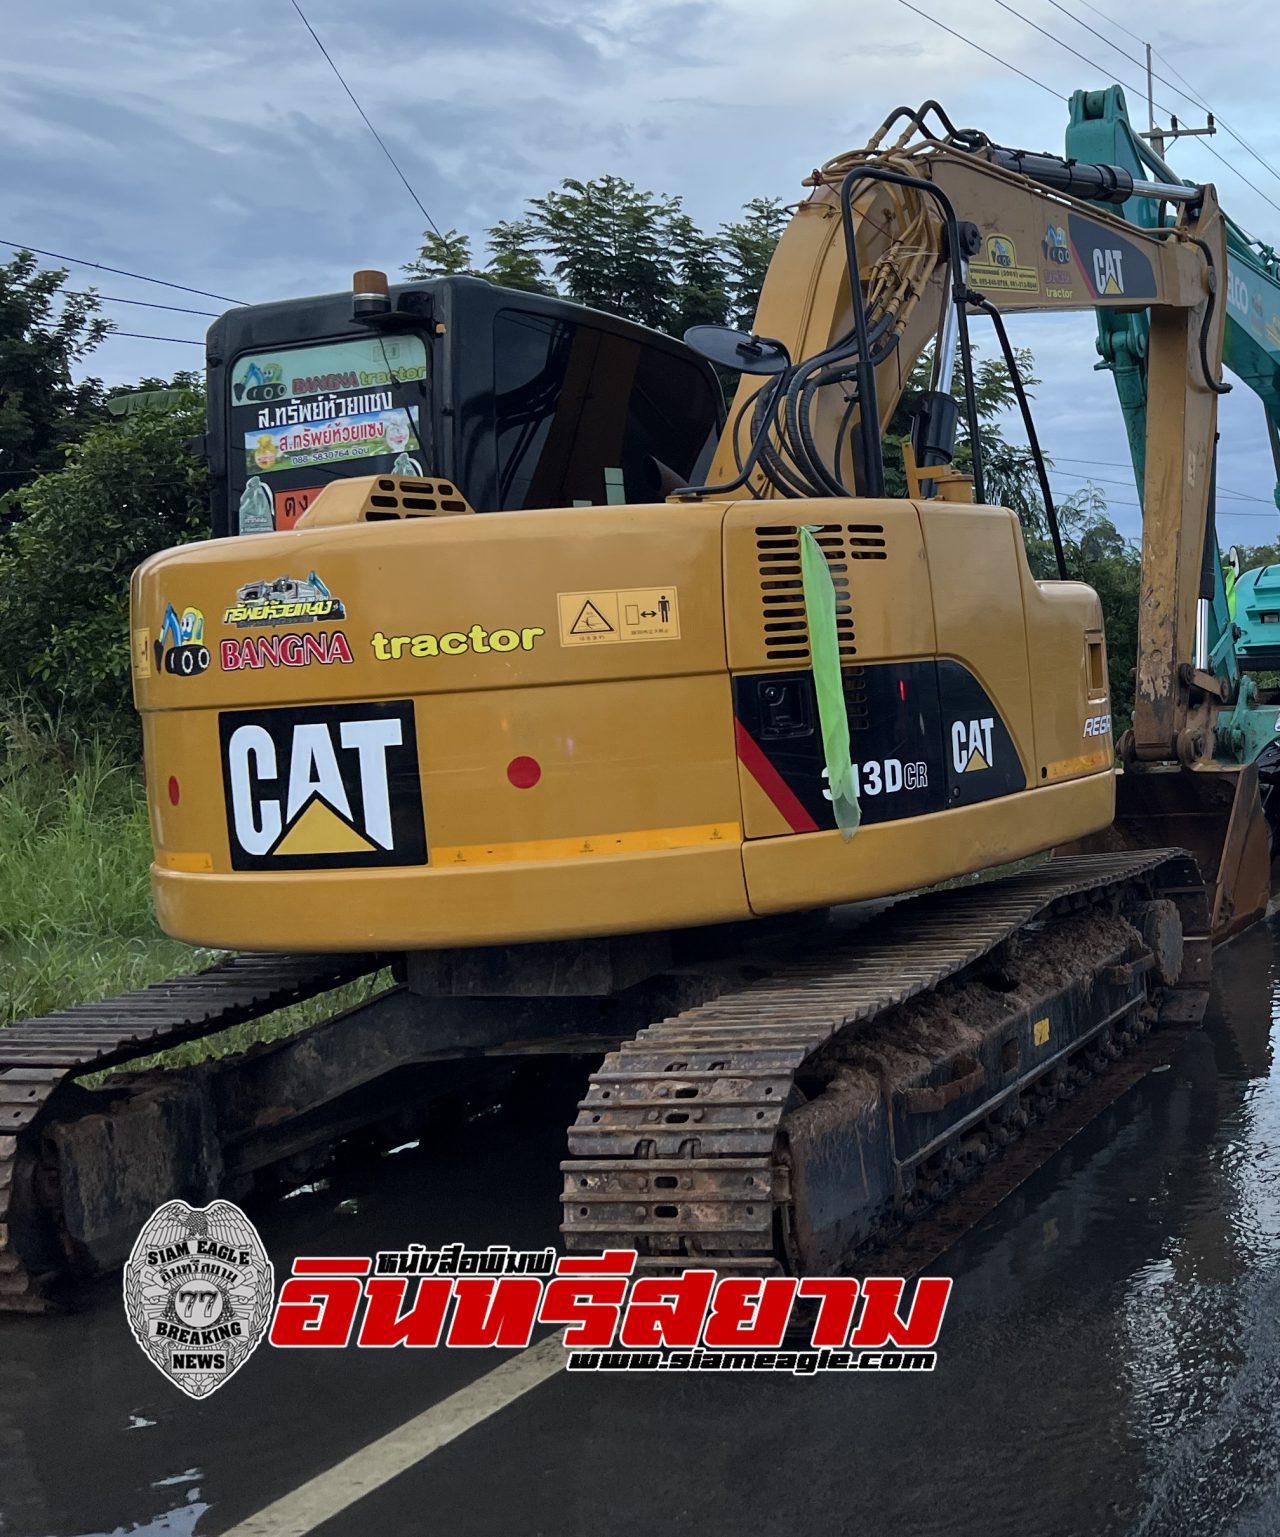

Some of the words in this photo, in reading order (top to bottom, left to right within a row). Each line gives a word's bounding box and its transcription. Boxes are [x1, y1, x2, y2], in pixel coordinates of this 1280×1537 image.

[1046, 287, 1073, 299] tractor
[1093, 249, 1124, 294] CAT
[291, 371, 359, 396] BANGNA
[360, 365, 426, 386] tractor
[220, 631, 354, 672] BANGNA
[370, 624, 545, 661] tractor
[951, 717, 995, 773] CAT
[229, 718, 403, 856] CAT
